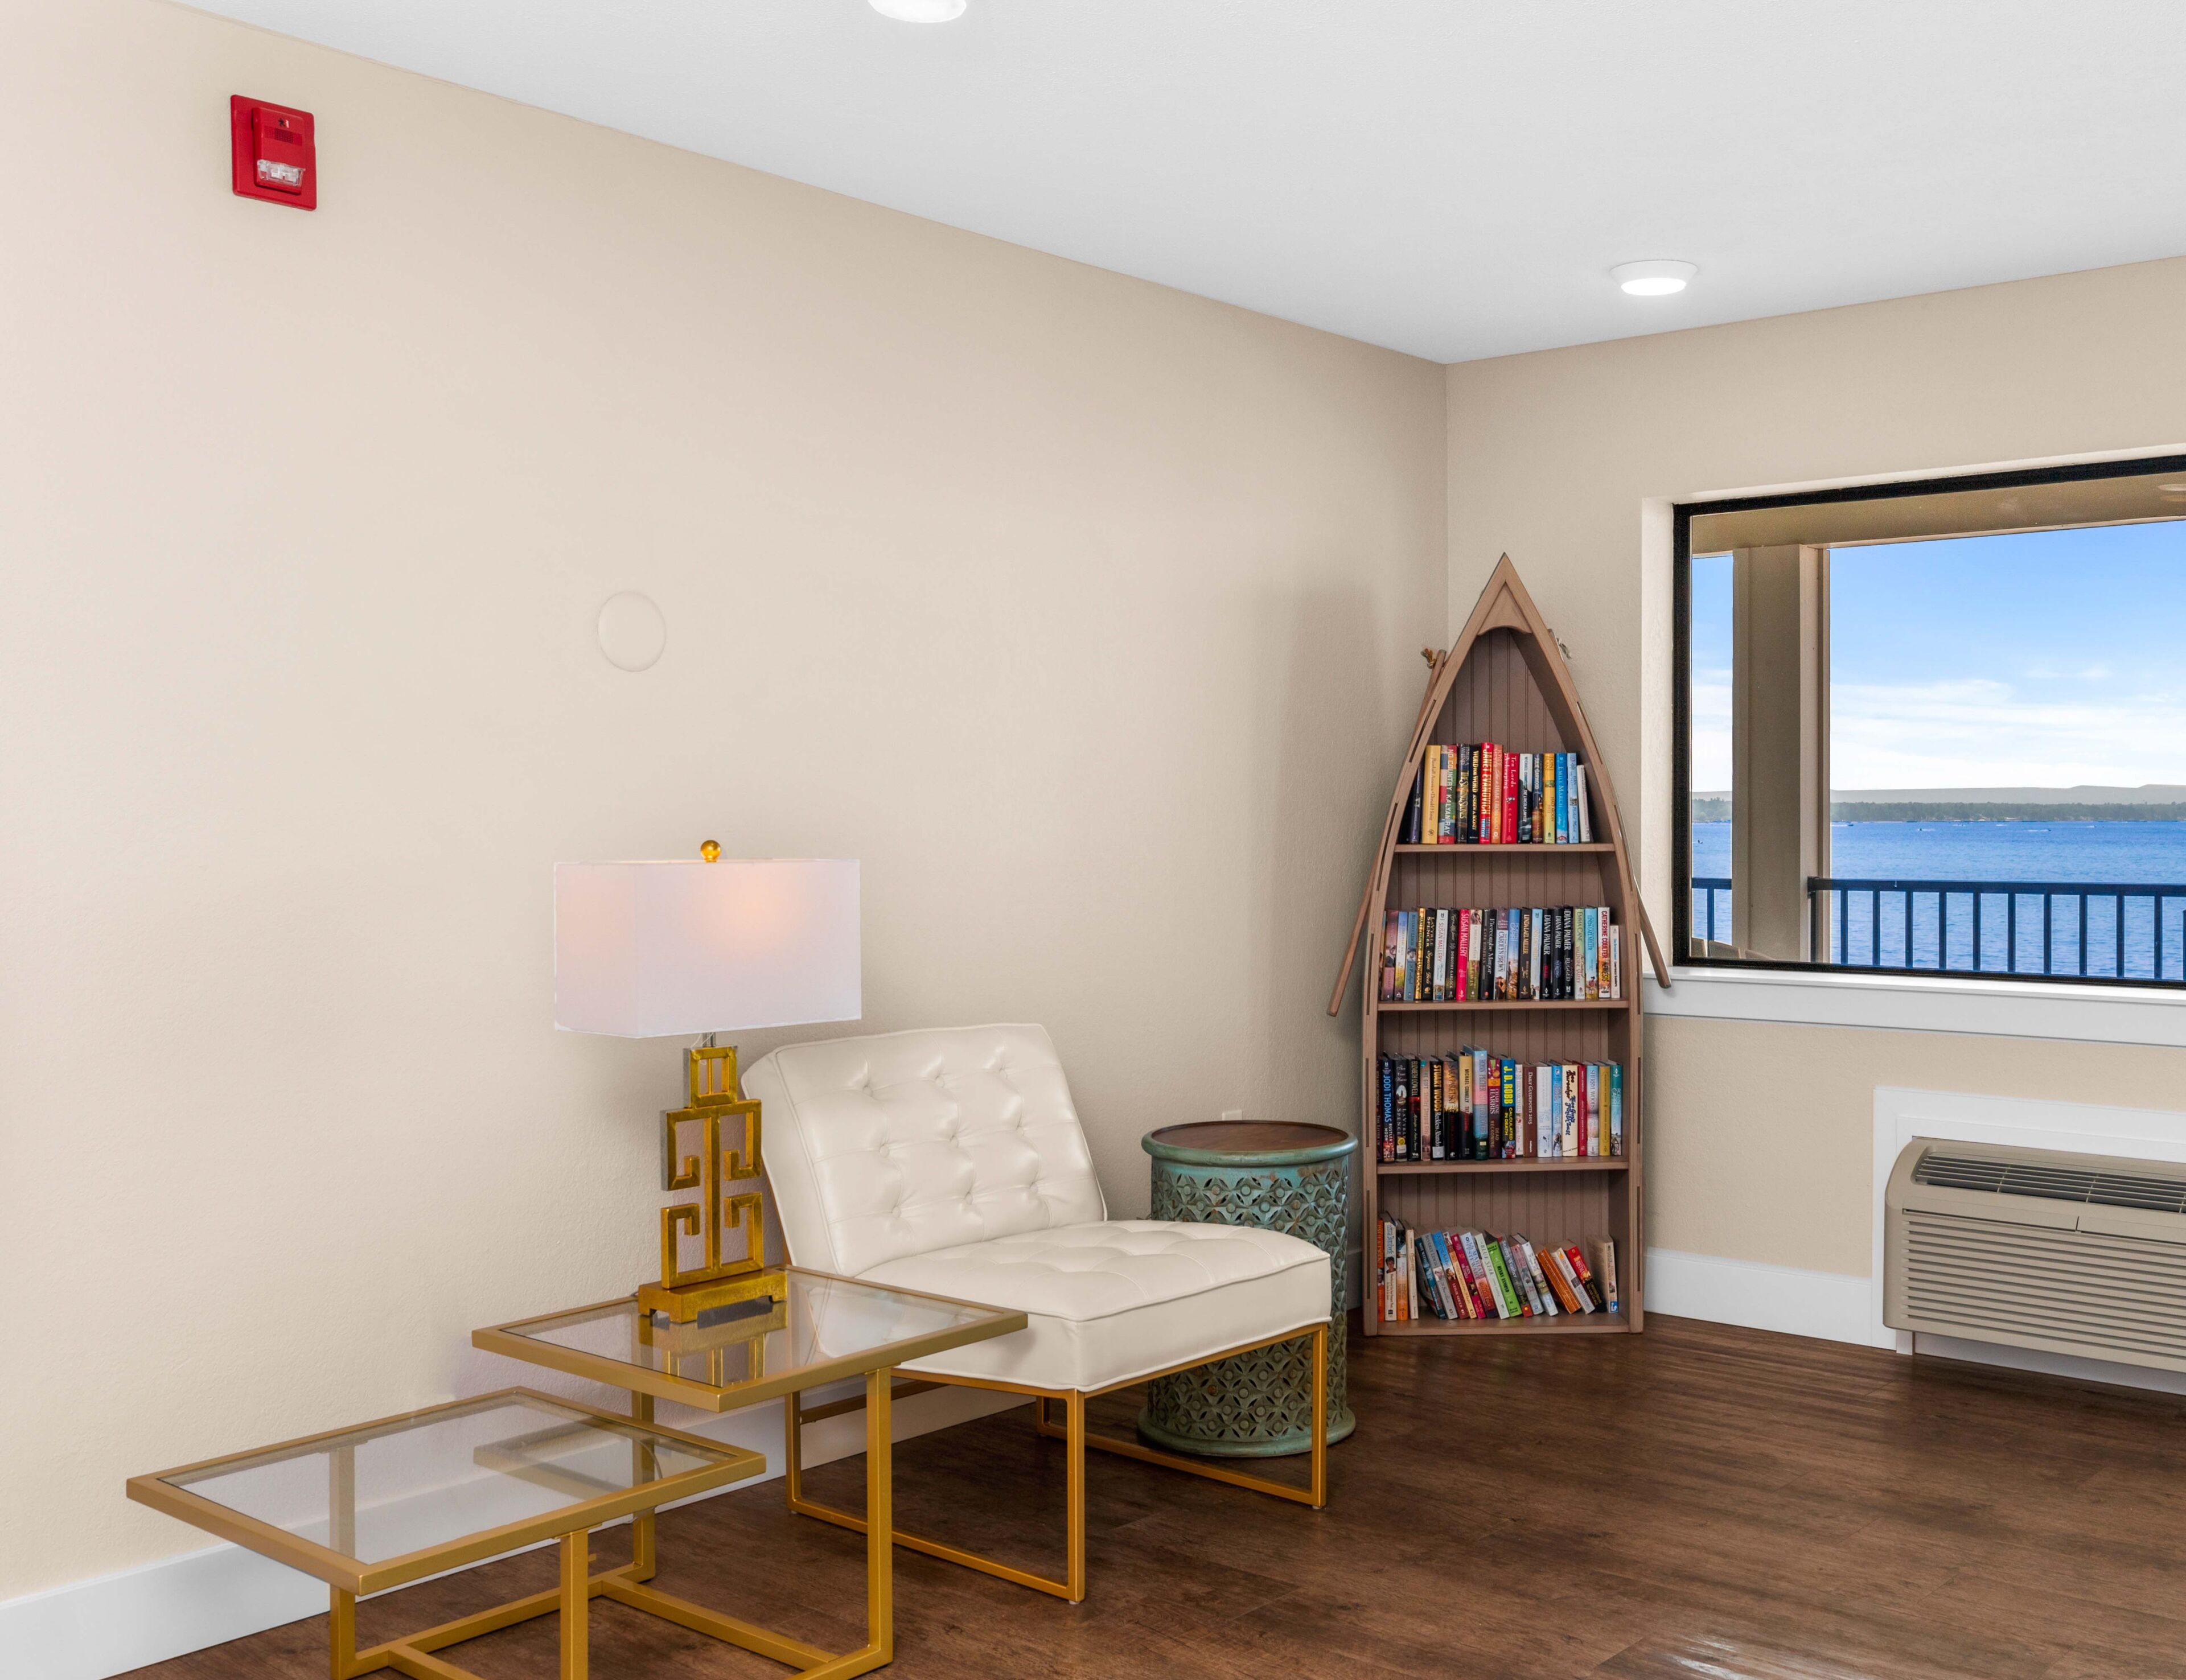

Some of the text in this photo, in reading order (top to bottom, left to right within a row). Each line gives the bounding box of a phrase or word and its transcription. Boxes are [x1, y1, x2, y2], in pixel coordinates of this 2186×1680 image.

[1448, 749, 1453, 757] NO
[1459, 780, 1469, 800] SINGING
[1481, 750, 1491, 814] JANET EVANOVICH
[1458, 801, 1468, 818] STONES
[1504, 1084, 1513, 1103] ROBB
[1424, 1234, 1433, 1253] BEVERLY
[1480, 1243, 1489, 1259] BLUE
[1467, 1250, 1480, 1279] STEWART
[1471, 1250, 1484, 1278] MARIAH
[1484, 1261, 1494, 1276] STAR
[1500, 1240, 1518, 1278] Stormy Weather
